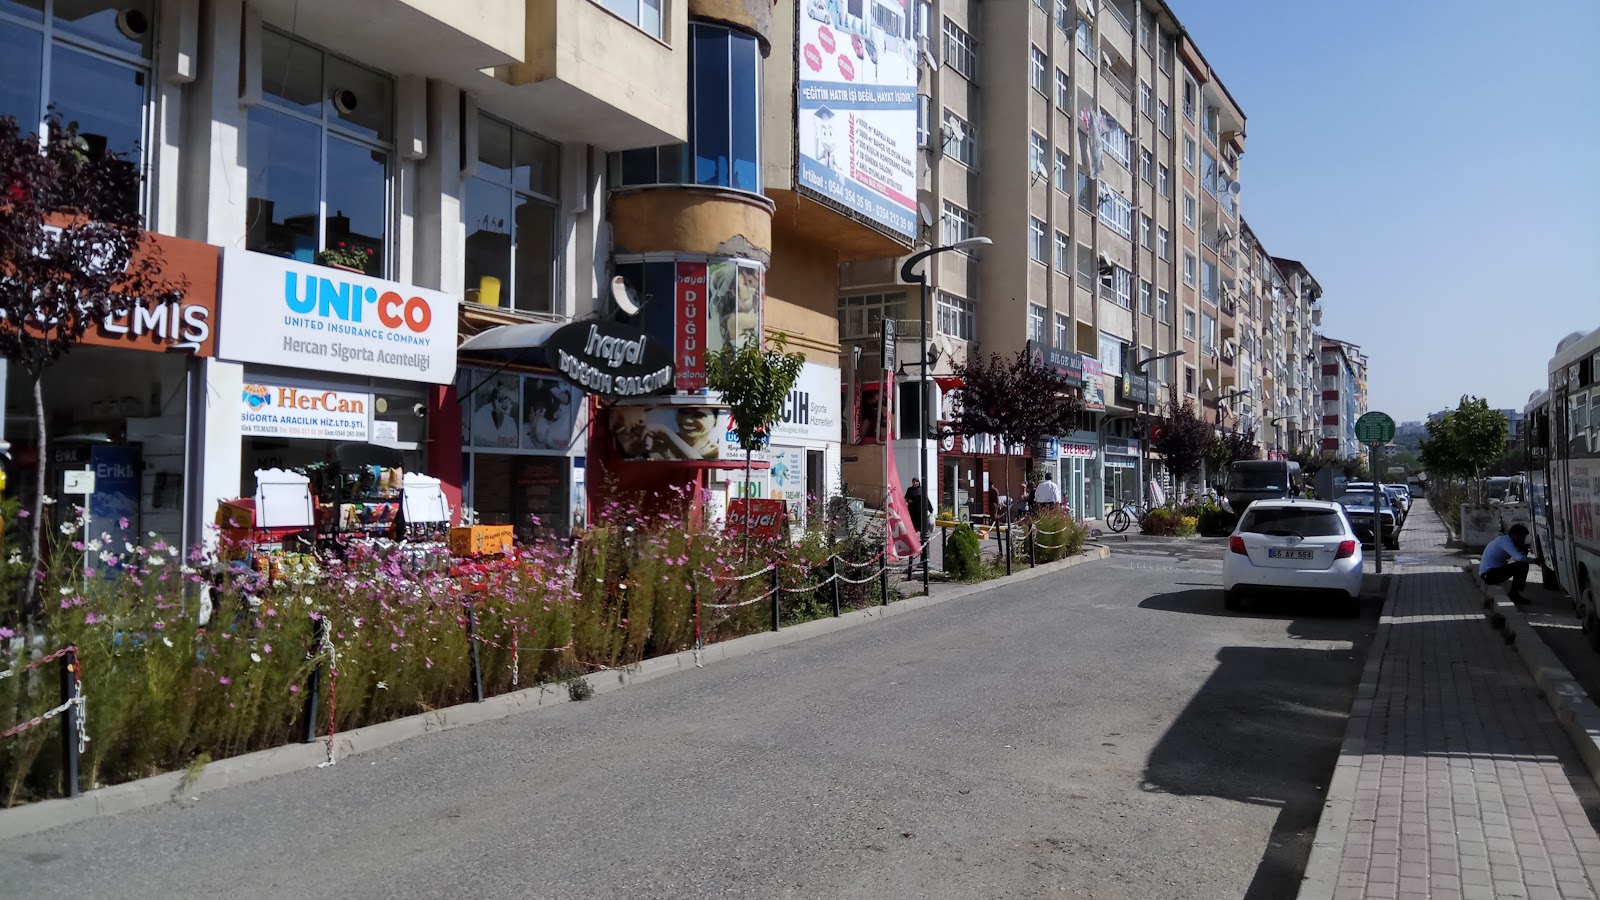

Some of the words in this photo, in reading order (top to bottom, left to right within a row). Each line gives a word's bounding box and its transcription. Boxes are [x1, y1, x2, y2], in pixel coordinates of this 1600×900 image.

[830, 88, 848, 101] HATIR
[877, 92, 894, 102] HAYAT
[802, 163, 824, 188] İrtibat
[828, 179, 843, 197] 0544
[845, 185, 856, 204] 354
[857, 193, 864, 208] 35
[876, 204, 890, 221] 0354
[890, 210, 899, 226] 212
[899, 215, 907, 230] 35
[677, 275, 706, 286] hayal
[284, 316, 324, 330] UNITED
[328, 322, 383, 339] INSURANCE
[387, 333, 431, 346] COMPANY
[684, 291, 697, 366] DÜĞÜN
[283, 336, 327, 356] Hercan
[331, 342, 374, 363] Sigorta
[377, 350, 430, 371] Acenteliği
[584, 324, 647, 368] hayal
[1050, 351, 1069, 367] BİLGE
[559, 348, 613, 394] DÜĞÜN
[277, 386, 365, 414] HerCan
[241, 412, 278, 423] SİGORTA
[280, 416, 318, 426] ARACILIK
[320, 417, 365, 429] HİZ.LTD.ŞTİ.
[1063, 444, 1073, 454] EFE
